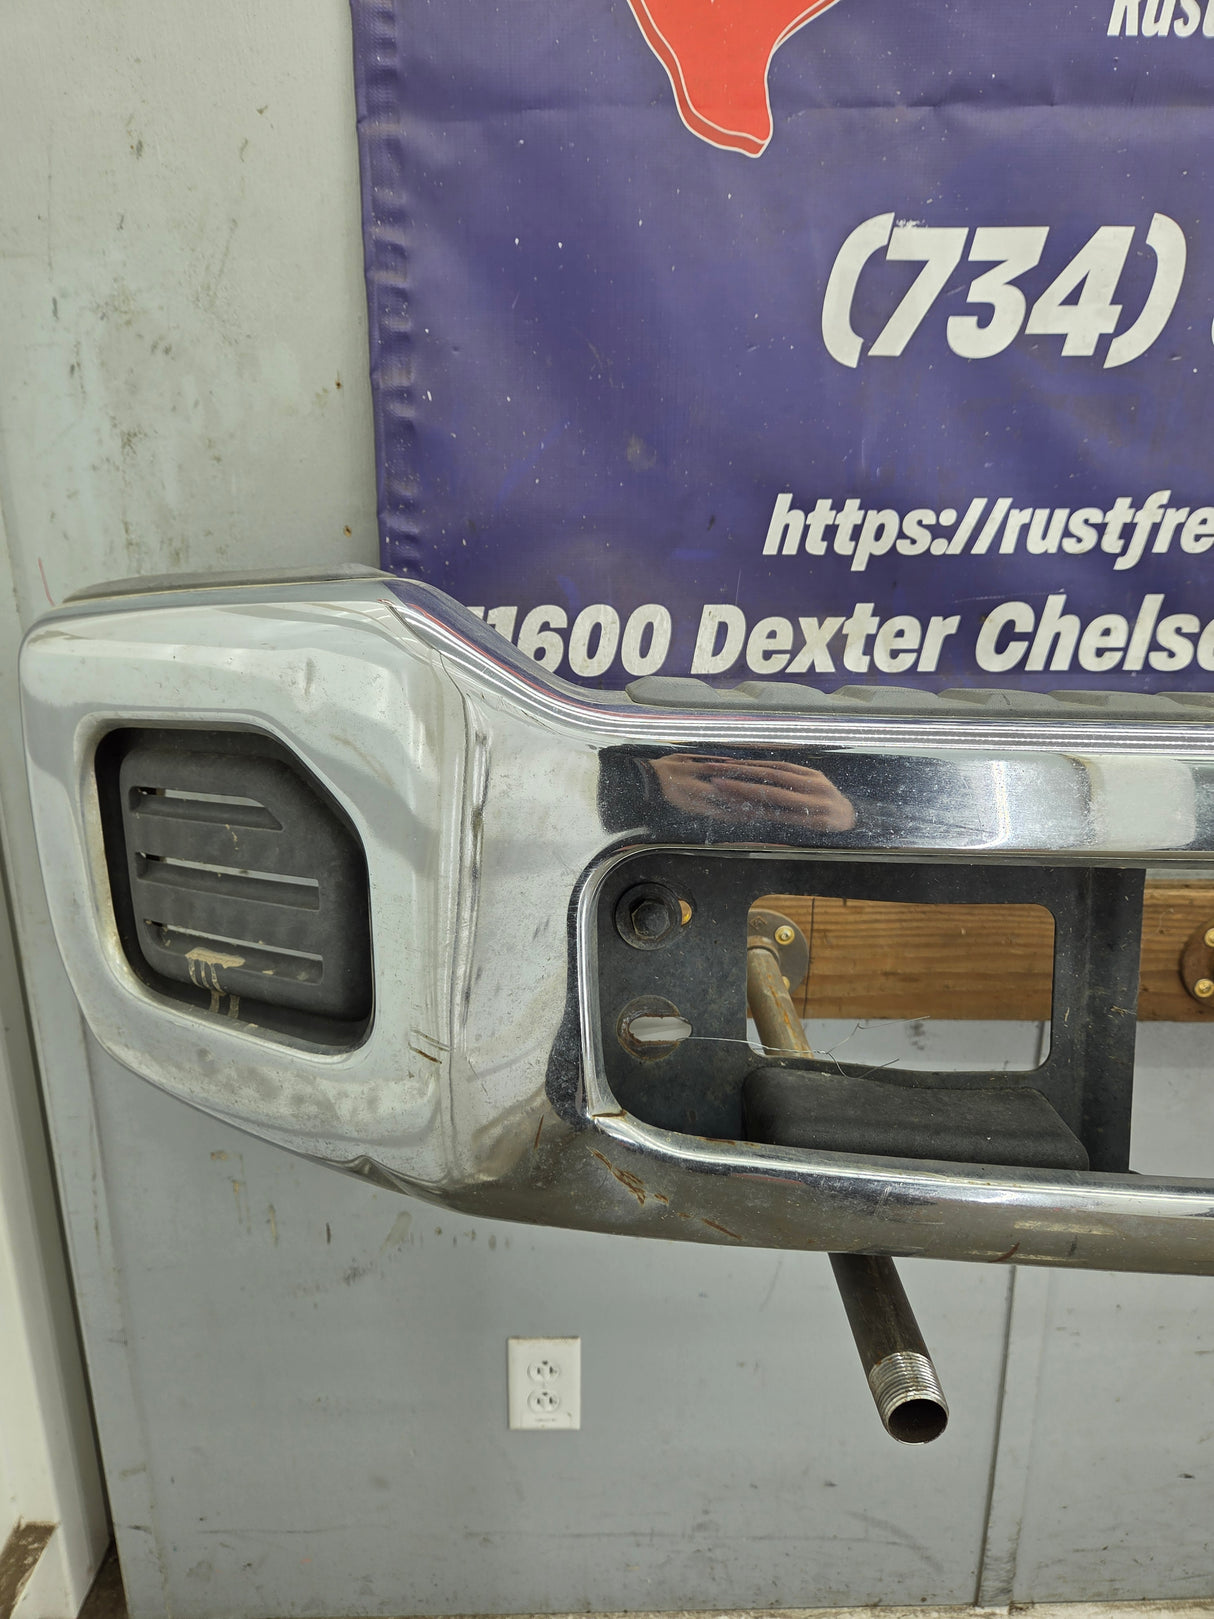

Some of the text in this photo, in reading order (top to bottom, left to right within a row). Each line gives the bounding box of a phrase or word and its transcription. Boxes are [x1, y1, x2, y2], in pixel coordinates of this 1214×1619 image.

[821, 212, 1187, 369] (734)
[466, 604, 672, 676] 1600
[690, 602, 961, 675] Dexter
